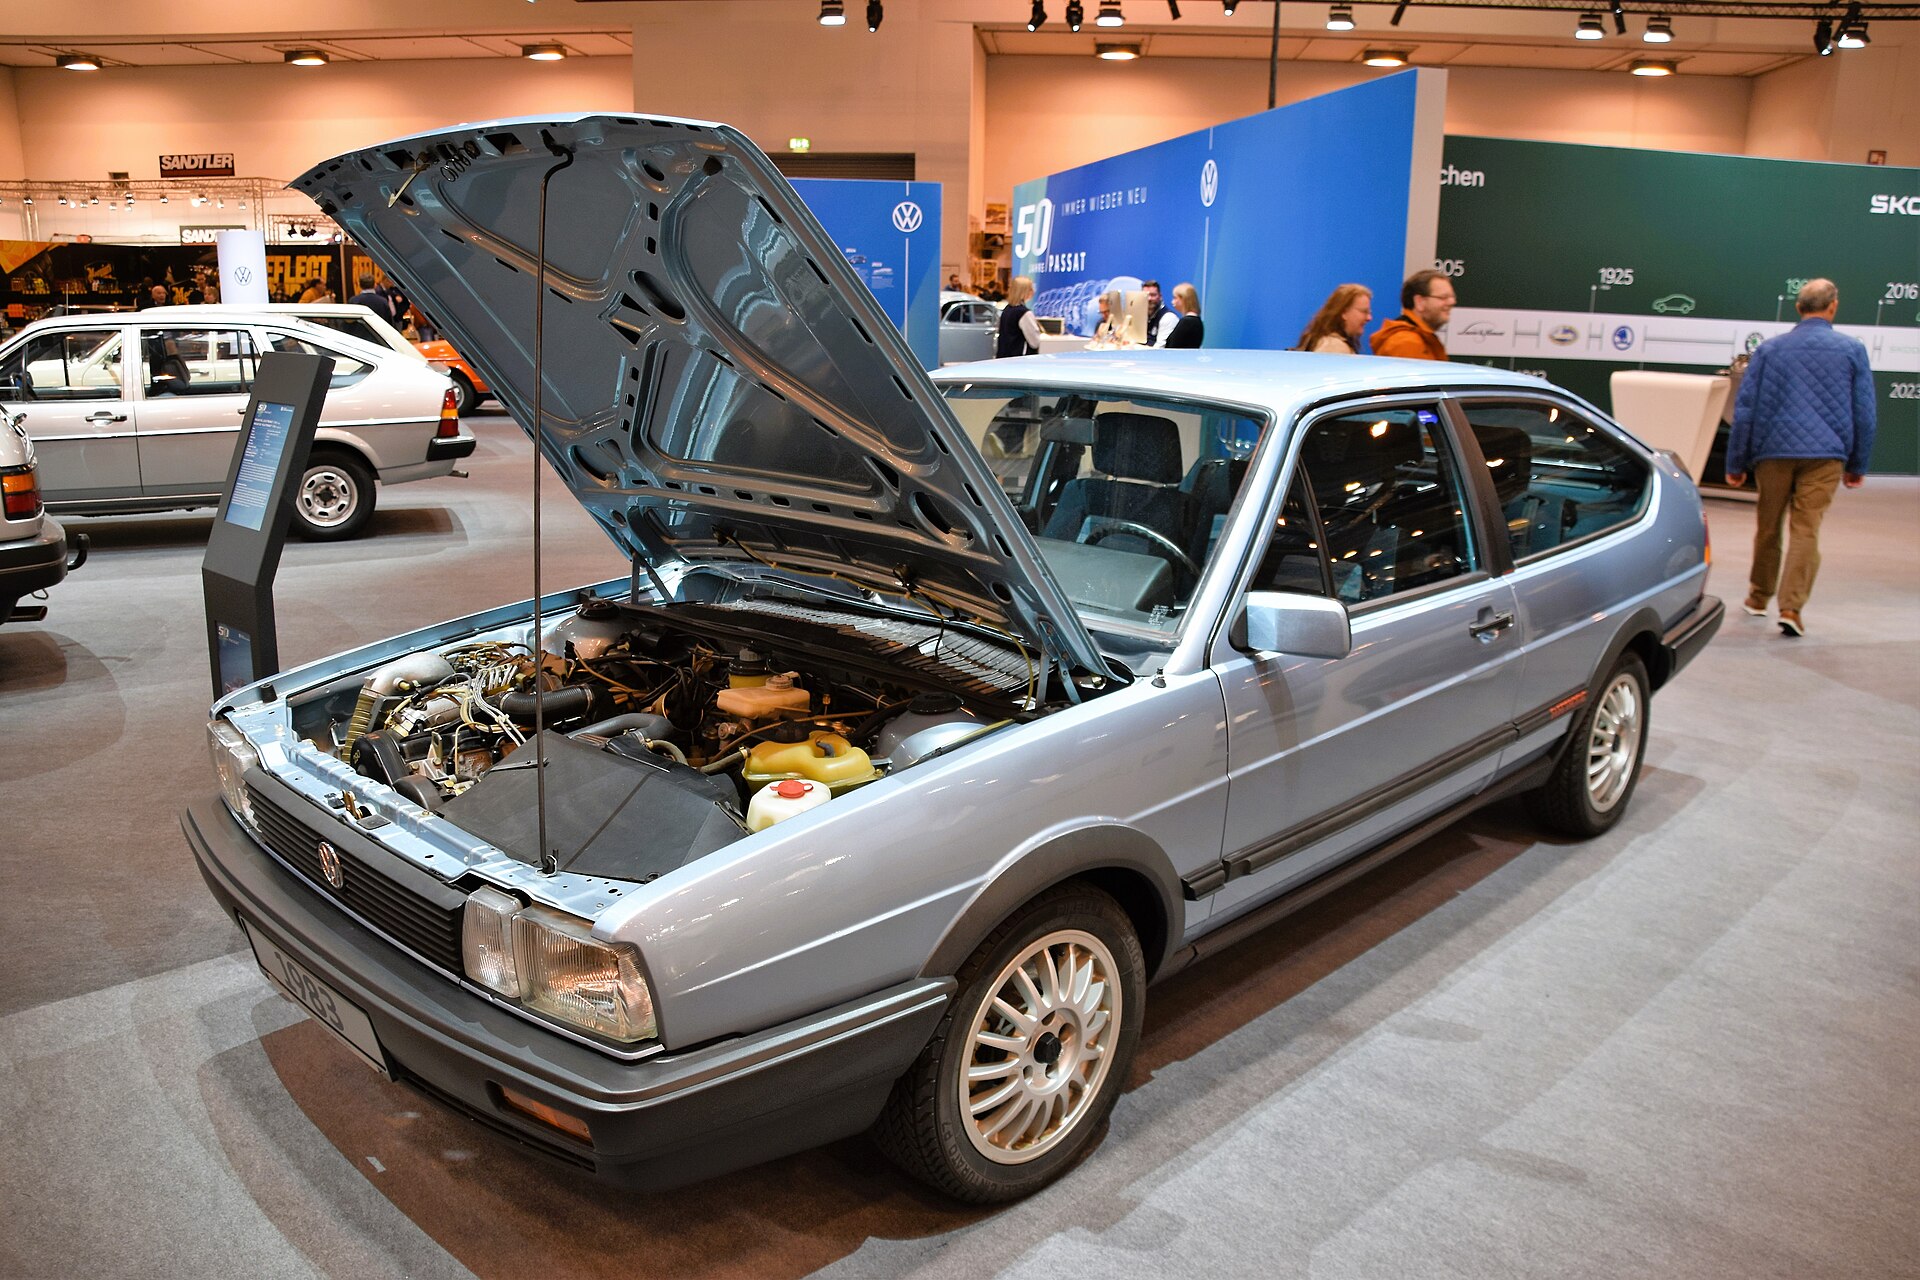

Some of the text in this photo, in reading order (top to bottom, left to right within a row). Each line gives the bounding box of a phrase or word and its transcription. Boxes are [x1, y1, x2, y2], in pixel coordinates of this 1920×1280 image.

[161, 154, 233, 170] SANDTLER
[1440, 164, 1485, 187] chen
[1061, 186, 1148, 217] IMMER WIEDER NEU
[181, 229, 222, 243] SAND
[1015, 198, 1053, 258] 50
[1049, 251, 1087, 273] PASSAT
[1599, 267, 1634, 285] 1925
[1884, 282, 1919, 299] 2016
[274, 951, 345, 1031] 1983
